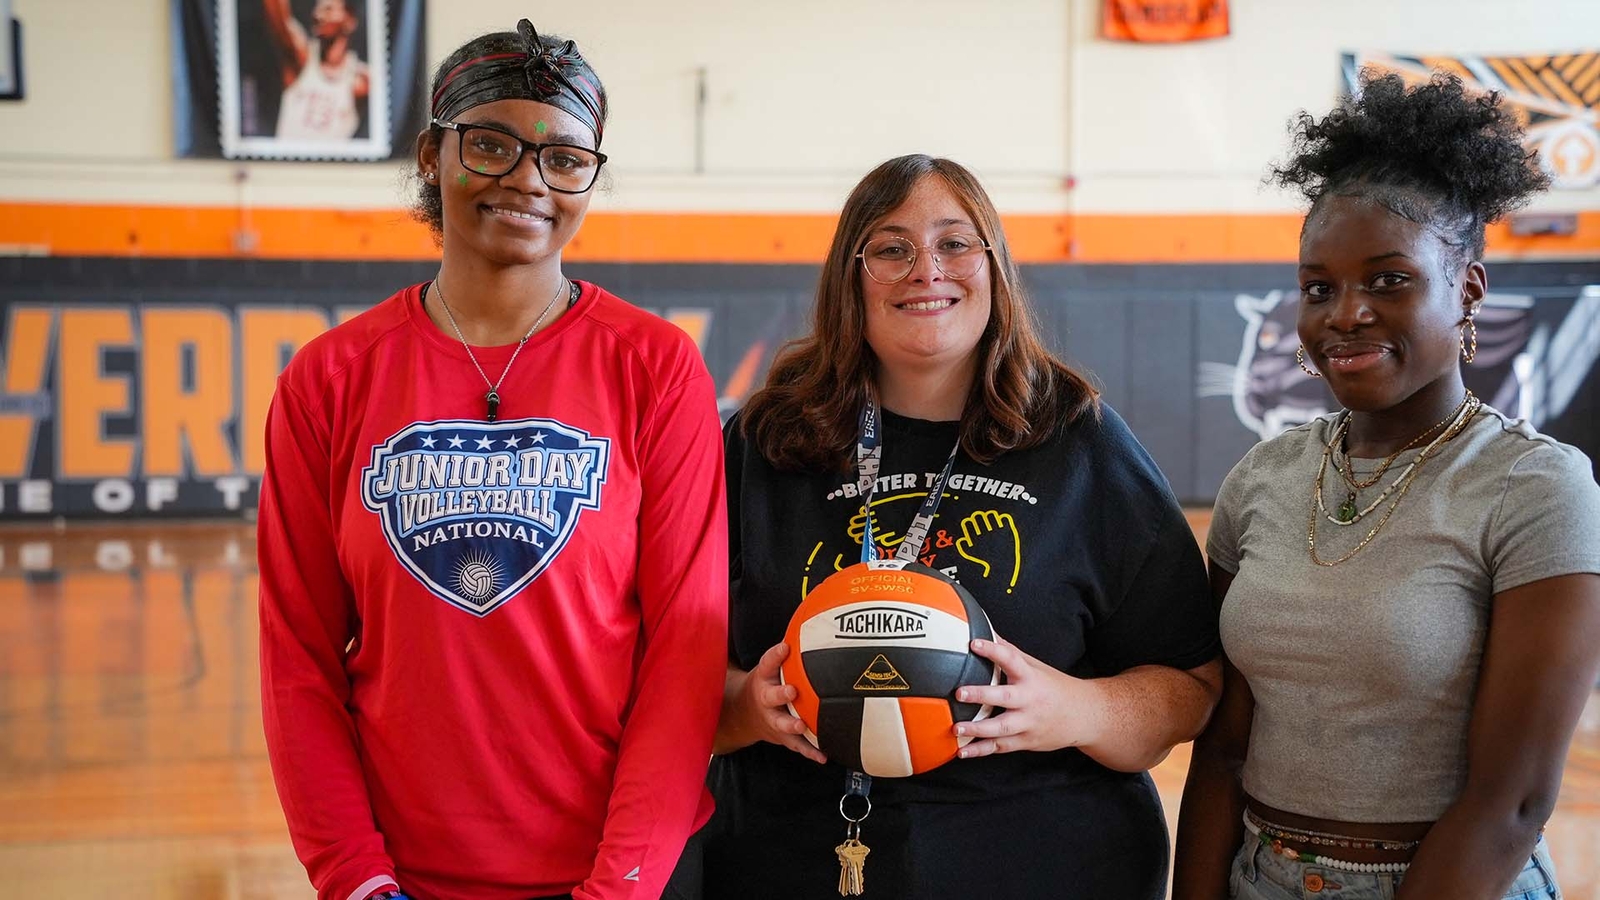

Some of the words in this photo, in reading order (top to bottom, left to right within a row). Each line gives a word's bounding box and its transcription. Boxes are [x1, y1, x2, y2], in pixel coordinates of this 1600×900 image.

[375, 453, 511, 494] JUNIOR
[519, 450, 592, 490] DAY
[842, 473, 917, 498] BTTER
[924, 472, 1025, 500] TGETHER
[92, 478, 178, 513] OF
[400, 489, 556, 532] VOLLEYBALL
[413, 521, 544, 552] NATIONAL
[934, 529, 954, 549] &
[850, 574, 914, 585] OFFICIAL
[835, 610, 925, 634] TACHIKARA
